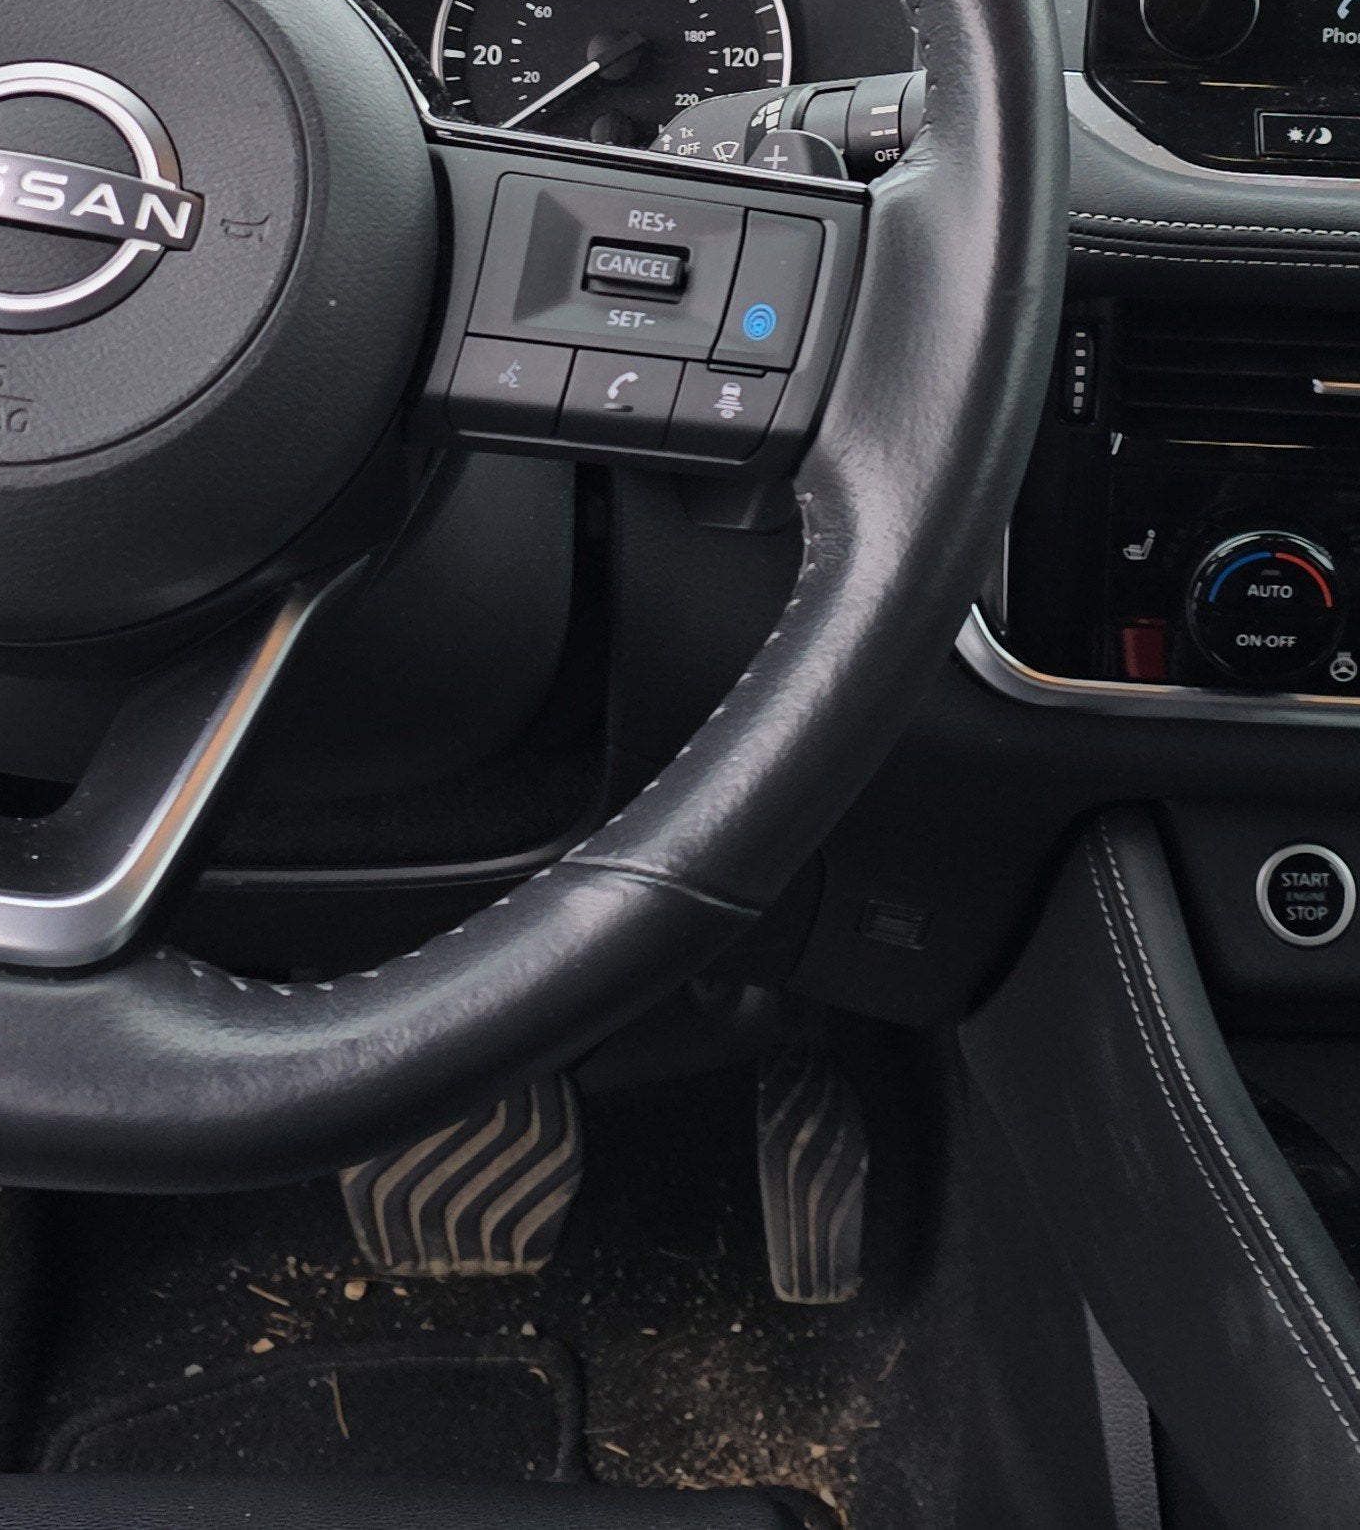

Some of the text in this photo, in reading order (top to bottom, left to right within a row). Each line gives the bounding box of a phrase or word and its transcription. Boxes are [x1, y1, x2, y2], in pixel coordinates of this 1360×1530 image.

[534, 5, 553, 19] 60
[684, 30, 707, 44] 180
[472, 45, 503, 66] 20
[722, 47, 760, 68] 120
[522, 70, 541, 84] 20
[675, 93, 699, 107] 220
[677, 141, 701, 157] OFF
[874, 148, 901, 163] OFF
[596, 252, 672, 281] CANCEL
[1246, 583, 1293, 599] AUTO
[1280, 872, 1330, 887] START
[1286, 906, 1329, 921] STOP
